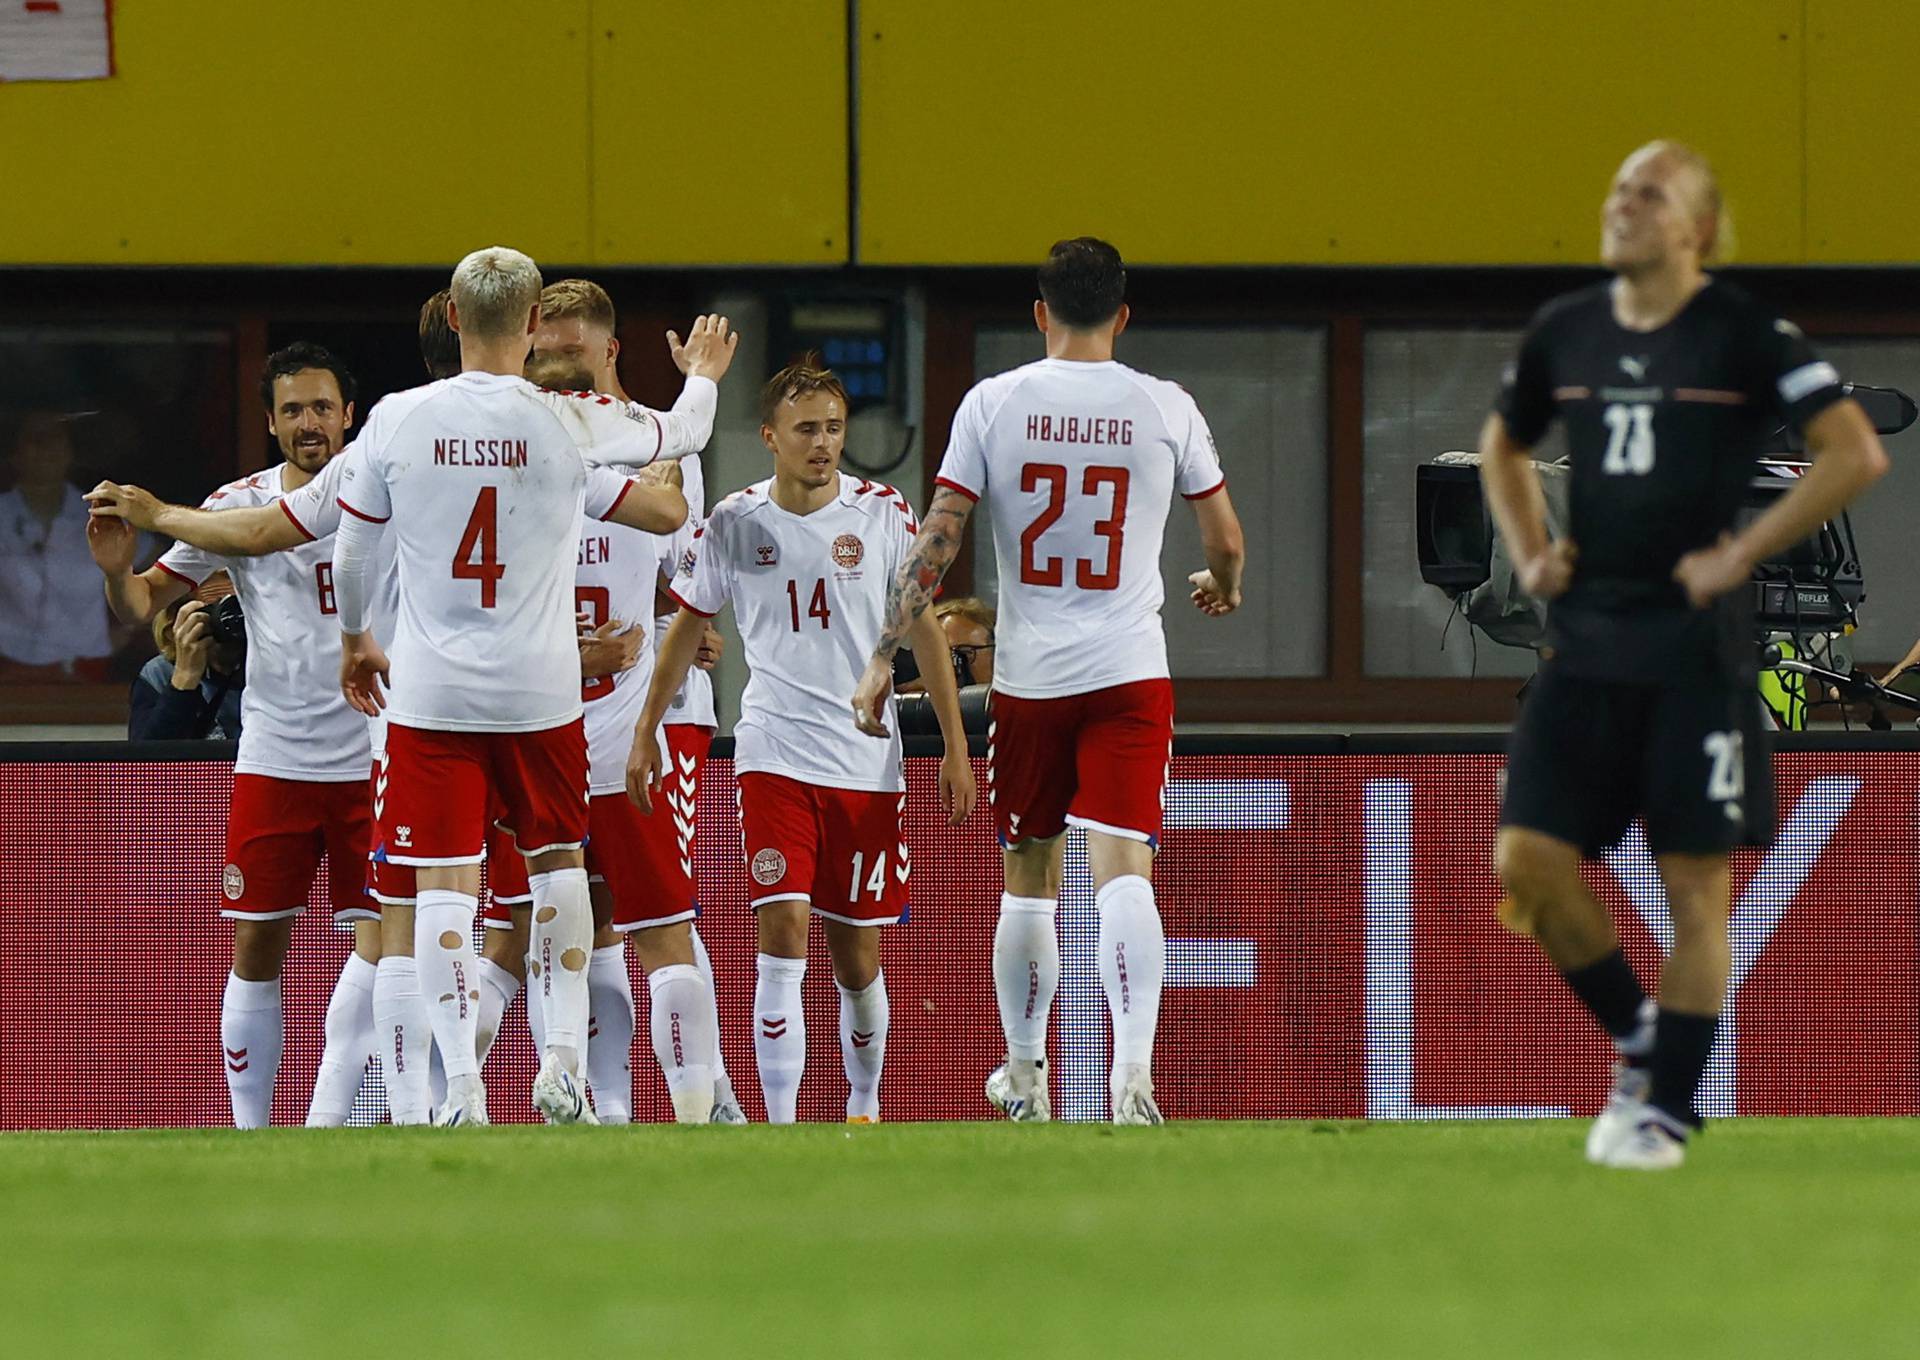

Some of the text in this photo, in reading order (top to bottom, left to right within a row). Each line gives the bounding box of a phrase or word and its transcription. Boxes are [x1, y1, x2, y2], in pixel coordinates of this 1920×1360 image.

[434, 439, 528, 468] NELSSON
[1026, 415, 1133, 446] HØJBJERG
[451, 486, 506, 609] 4
[1019, 463, 1130, 591] 23
[315, 561, 337, 615] 8
[786, 578, 831, 632] 14
[849, 850, 886, 903] 14
[452, 960, 468, 1020] DANMARK
